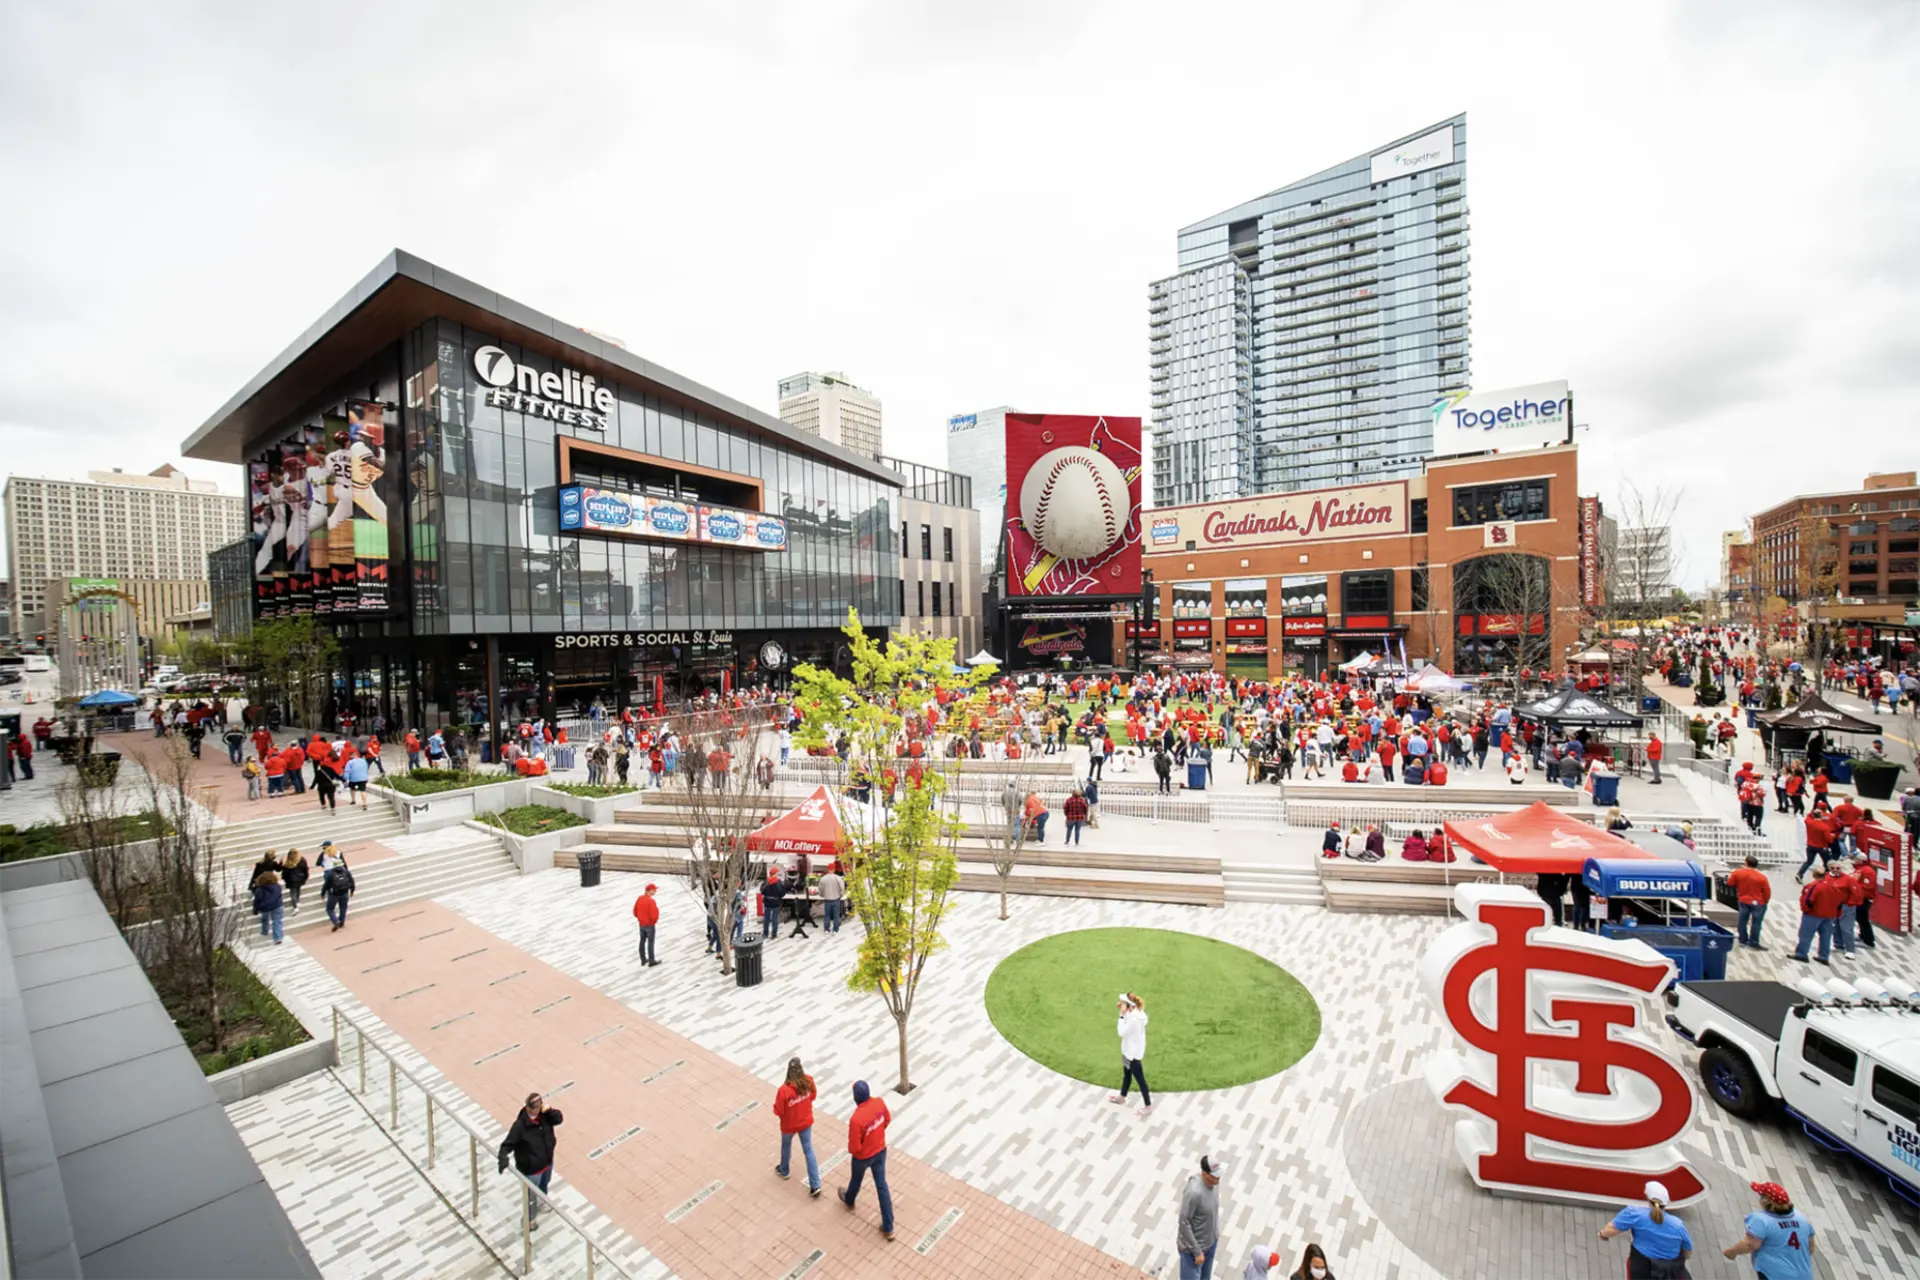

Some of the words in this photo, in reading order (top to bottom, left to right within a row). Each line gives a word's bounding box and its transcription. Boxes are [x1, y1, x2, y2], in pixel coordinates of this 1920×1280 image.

[1402, 151, 1440, 167] Together
[491, 389, 609, 431] FITNESS
[1451, 398, 1567, 430] Together
[1203, 510, 1299, 544] Cardinals
[1300, 498, 1392, 536] Nation
[555, 634, 619, 649] SPORTS
[623, 633, 634, 646] &
[637, 632, 690, 645] SOCIAL
[692, 631, 706, 644] St.
[708, 629, 733, 647] Louis
[1620, 880, 1649, 890] BUD
[1650, 881, 1690, 891] LIGHT
[1787, 1231, 1800, 1251] 4
